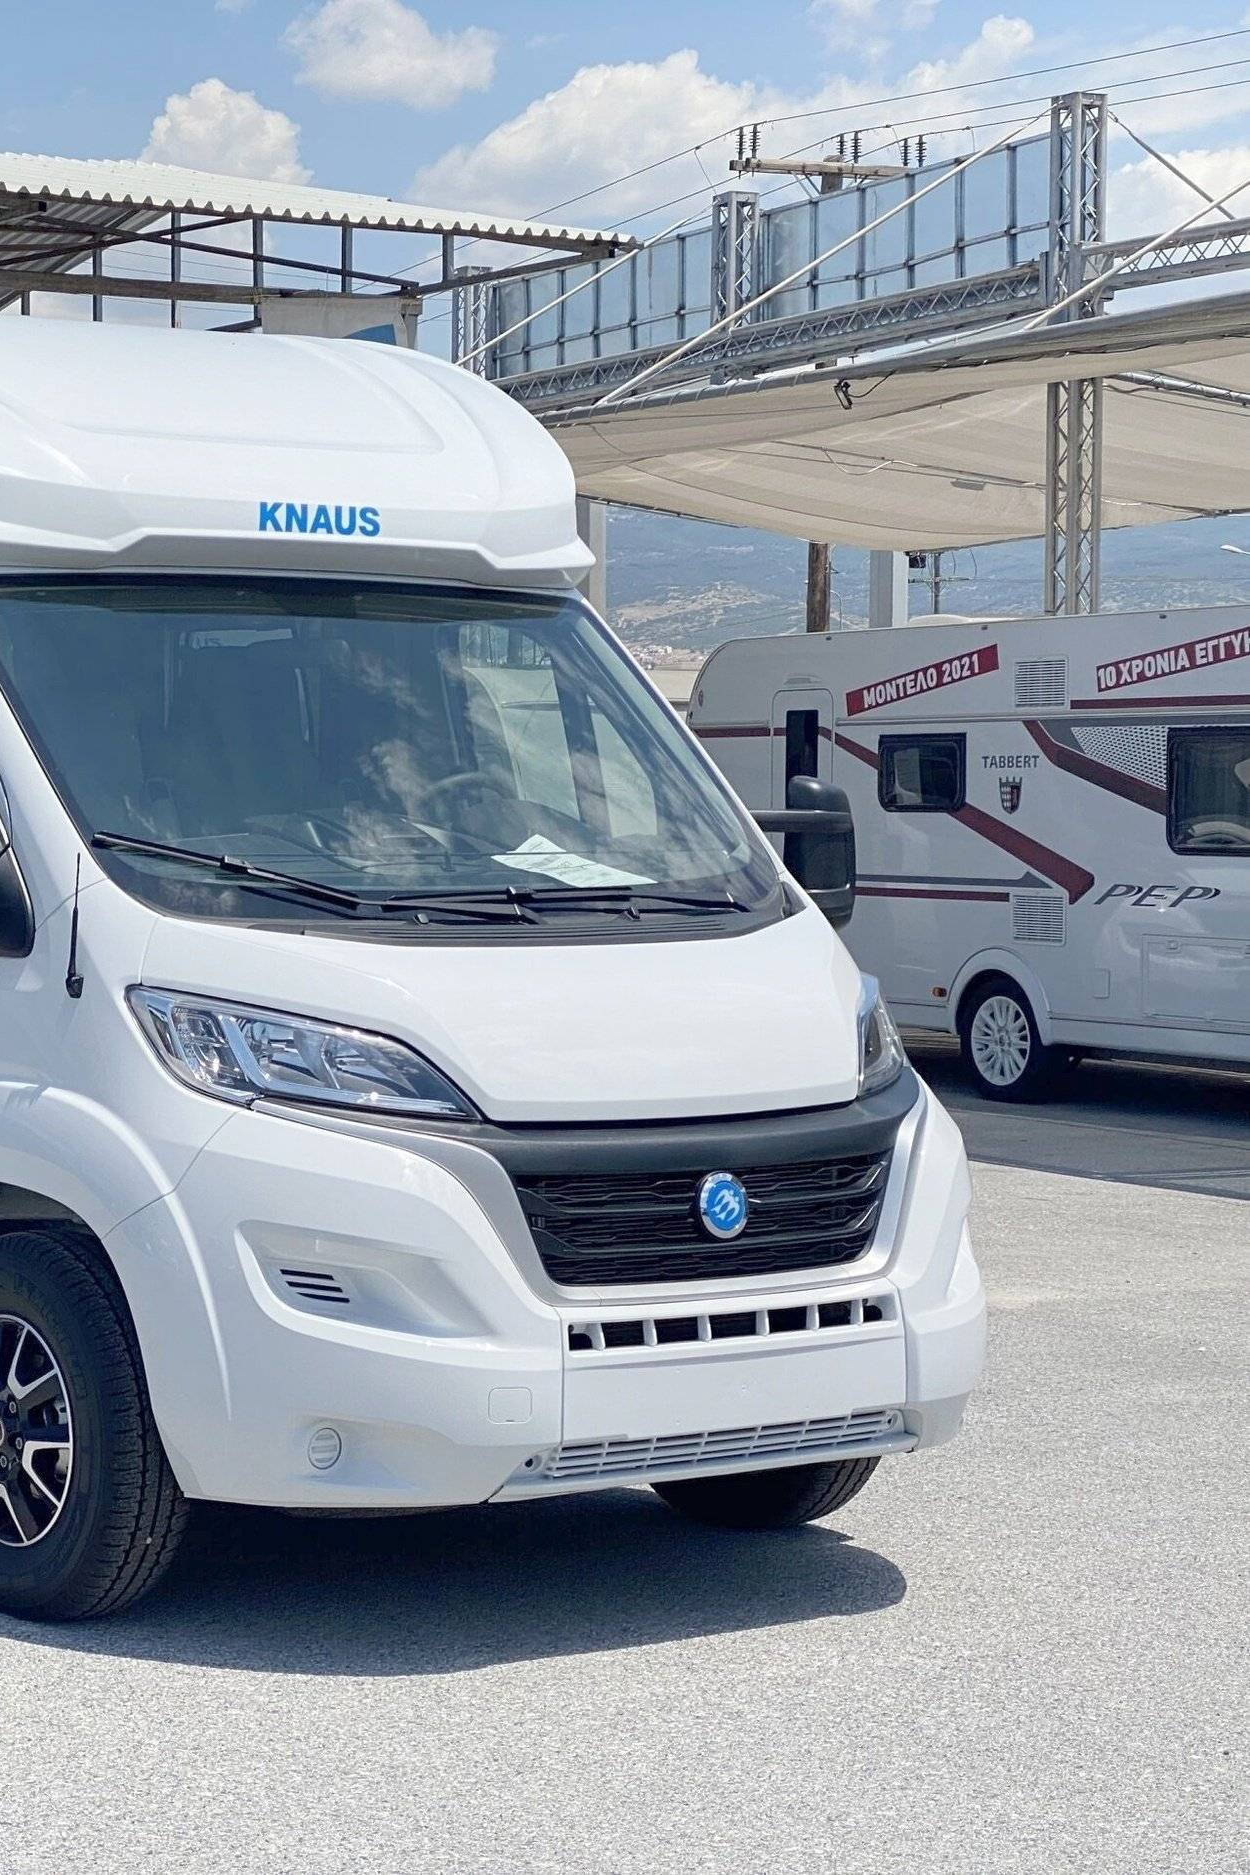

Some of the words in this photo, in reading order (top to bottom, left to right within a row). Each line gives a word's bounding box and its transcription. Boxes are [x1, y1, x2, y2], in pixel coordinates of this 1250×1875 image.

[259, 501, 381, 537] KNAUS
[863, 667, 937, 708] ΜΟΝΤΕΛΟ
[942, 653, 979, 684] 2021
[1098, 667, 1117, 689] 10
[1118, 648, 1190, 685] ΧΡΟΝΙΑ
[981, 754, 1040, 769] TABBERT
[1093, 884, 1221, 908] PEP
